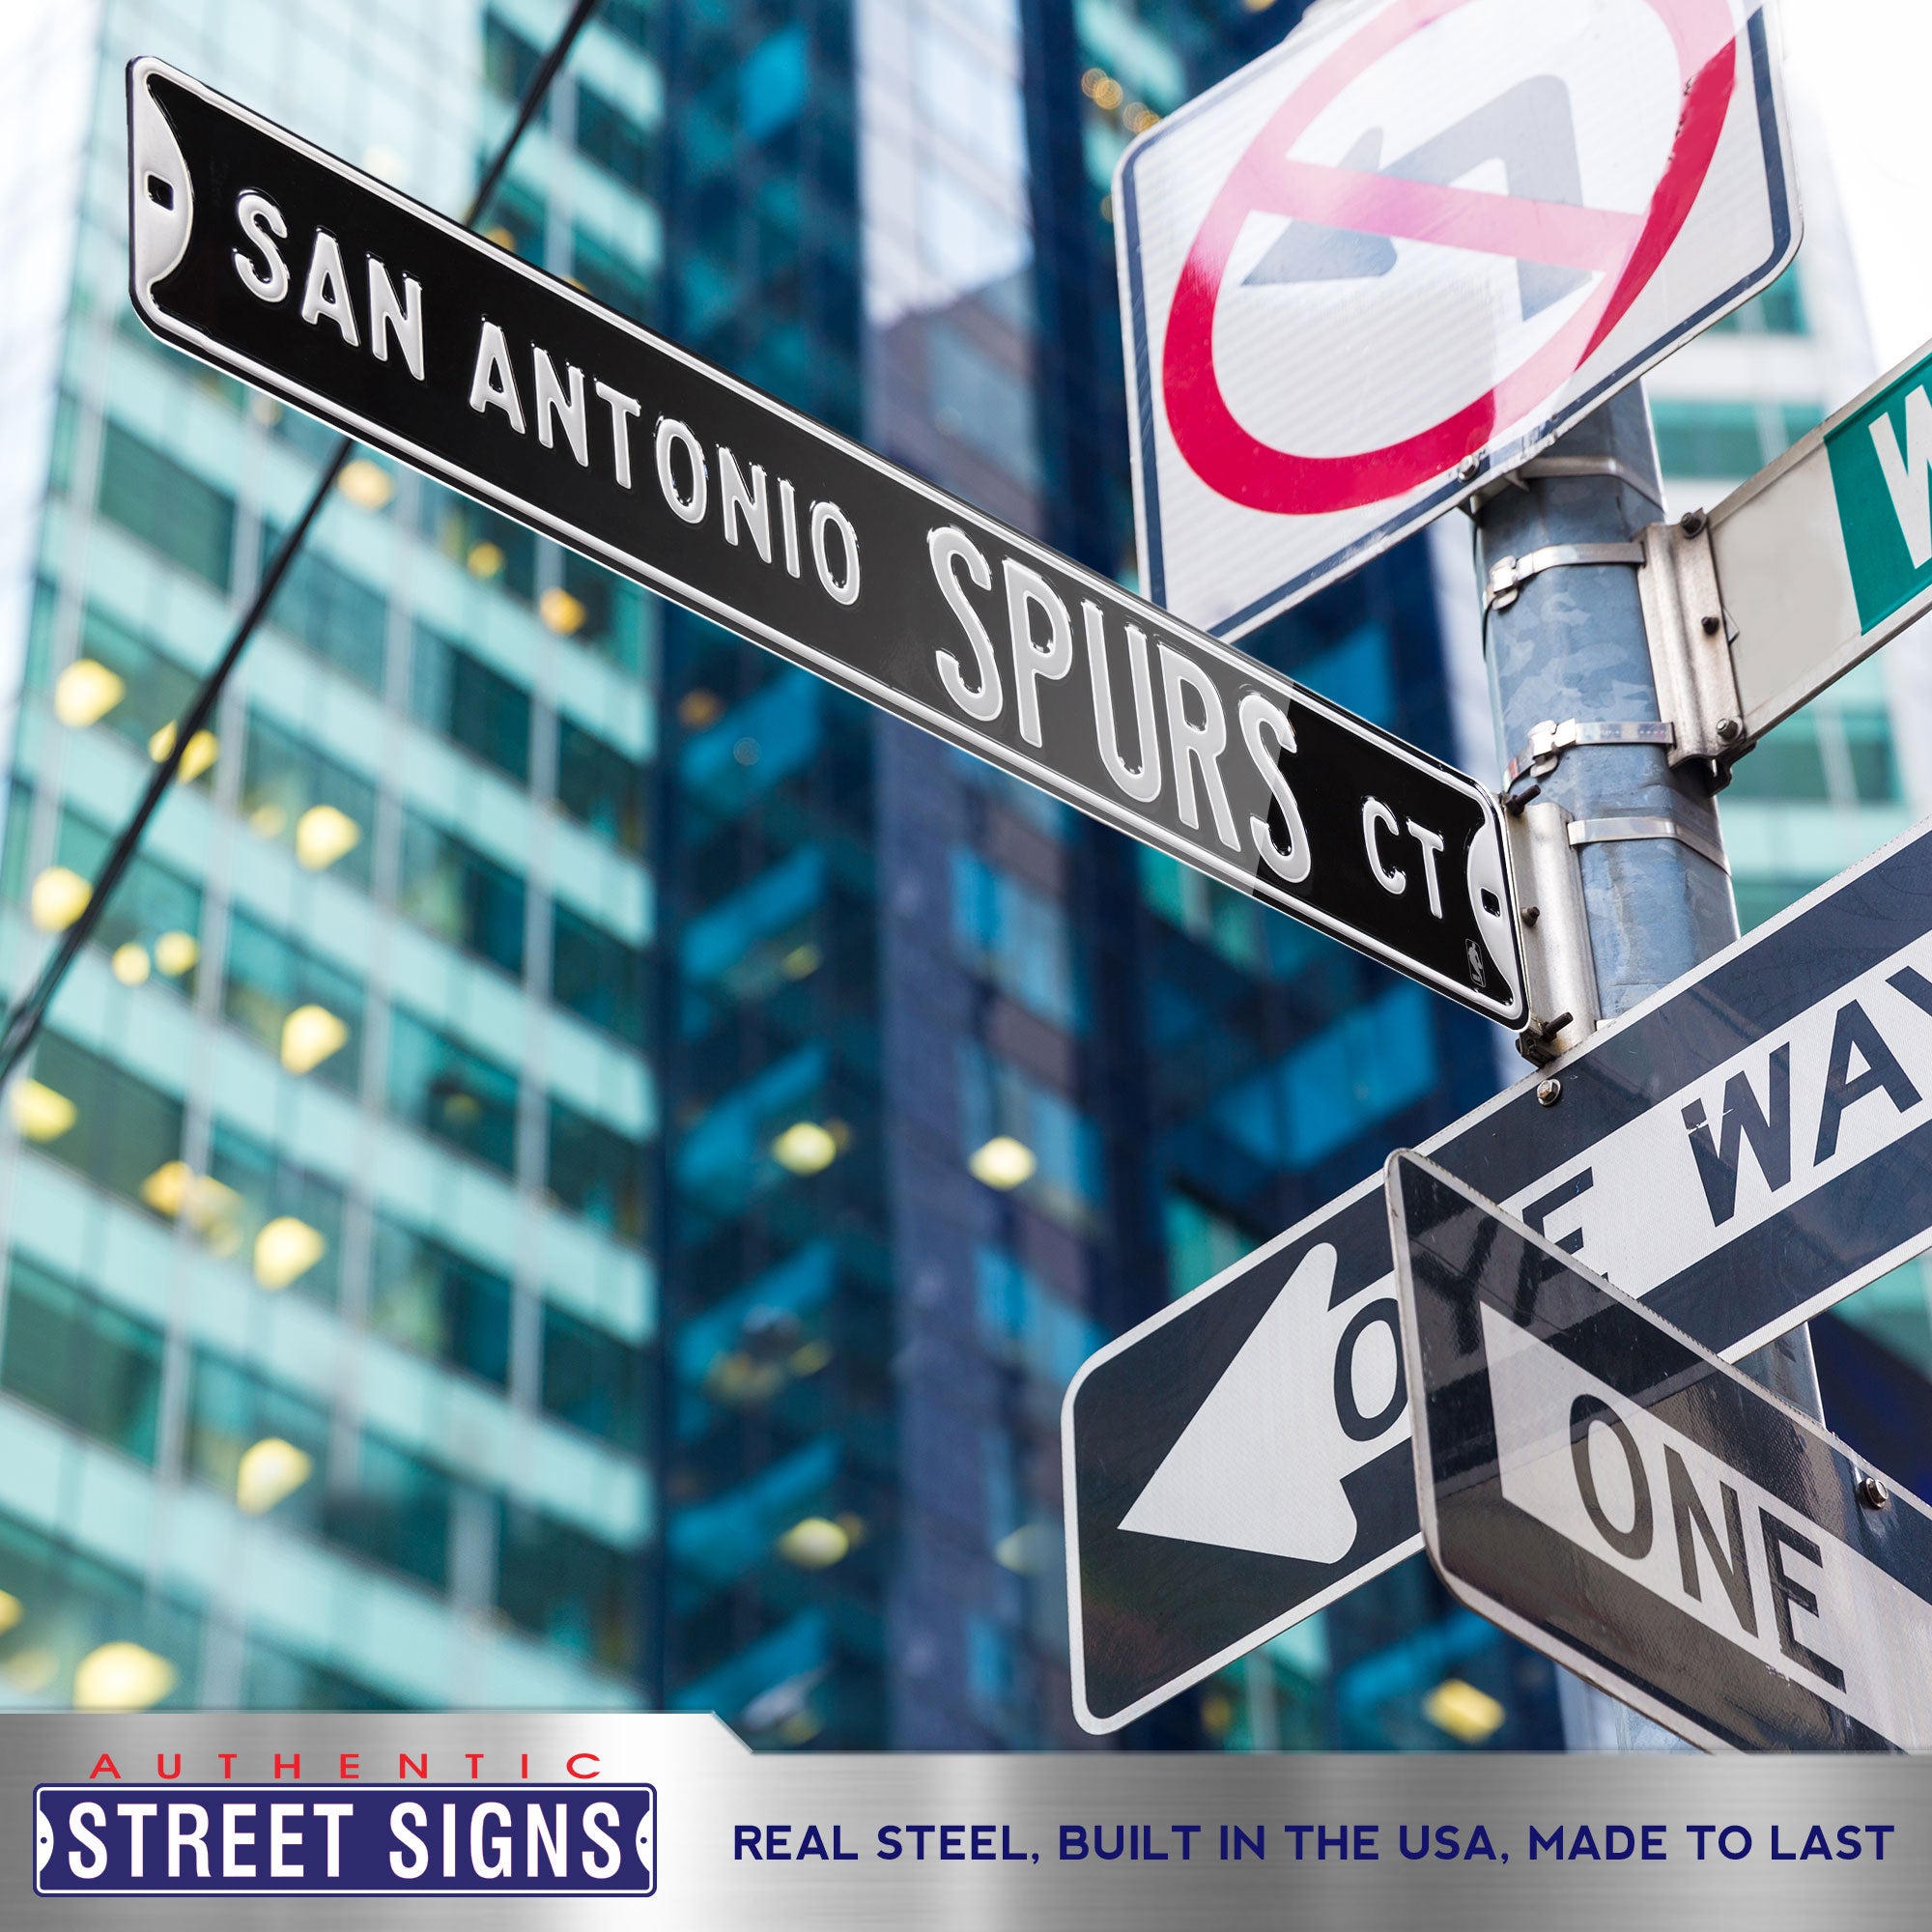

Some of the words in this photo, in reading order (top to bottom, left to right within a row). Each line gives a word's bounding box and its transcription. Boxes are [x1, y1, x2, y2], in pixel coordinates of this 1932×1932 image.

[233, 189, 425, 381] SAN
[469, 318, 860, 606] ANTONIO
[927, 526, 1311, 883] SPURS
[1362, 796, 1443, 918] CT
[1570, 1394, 1847, 1694] ONE
